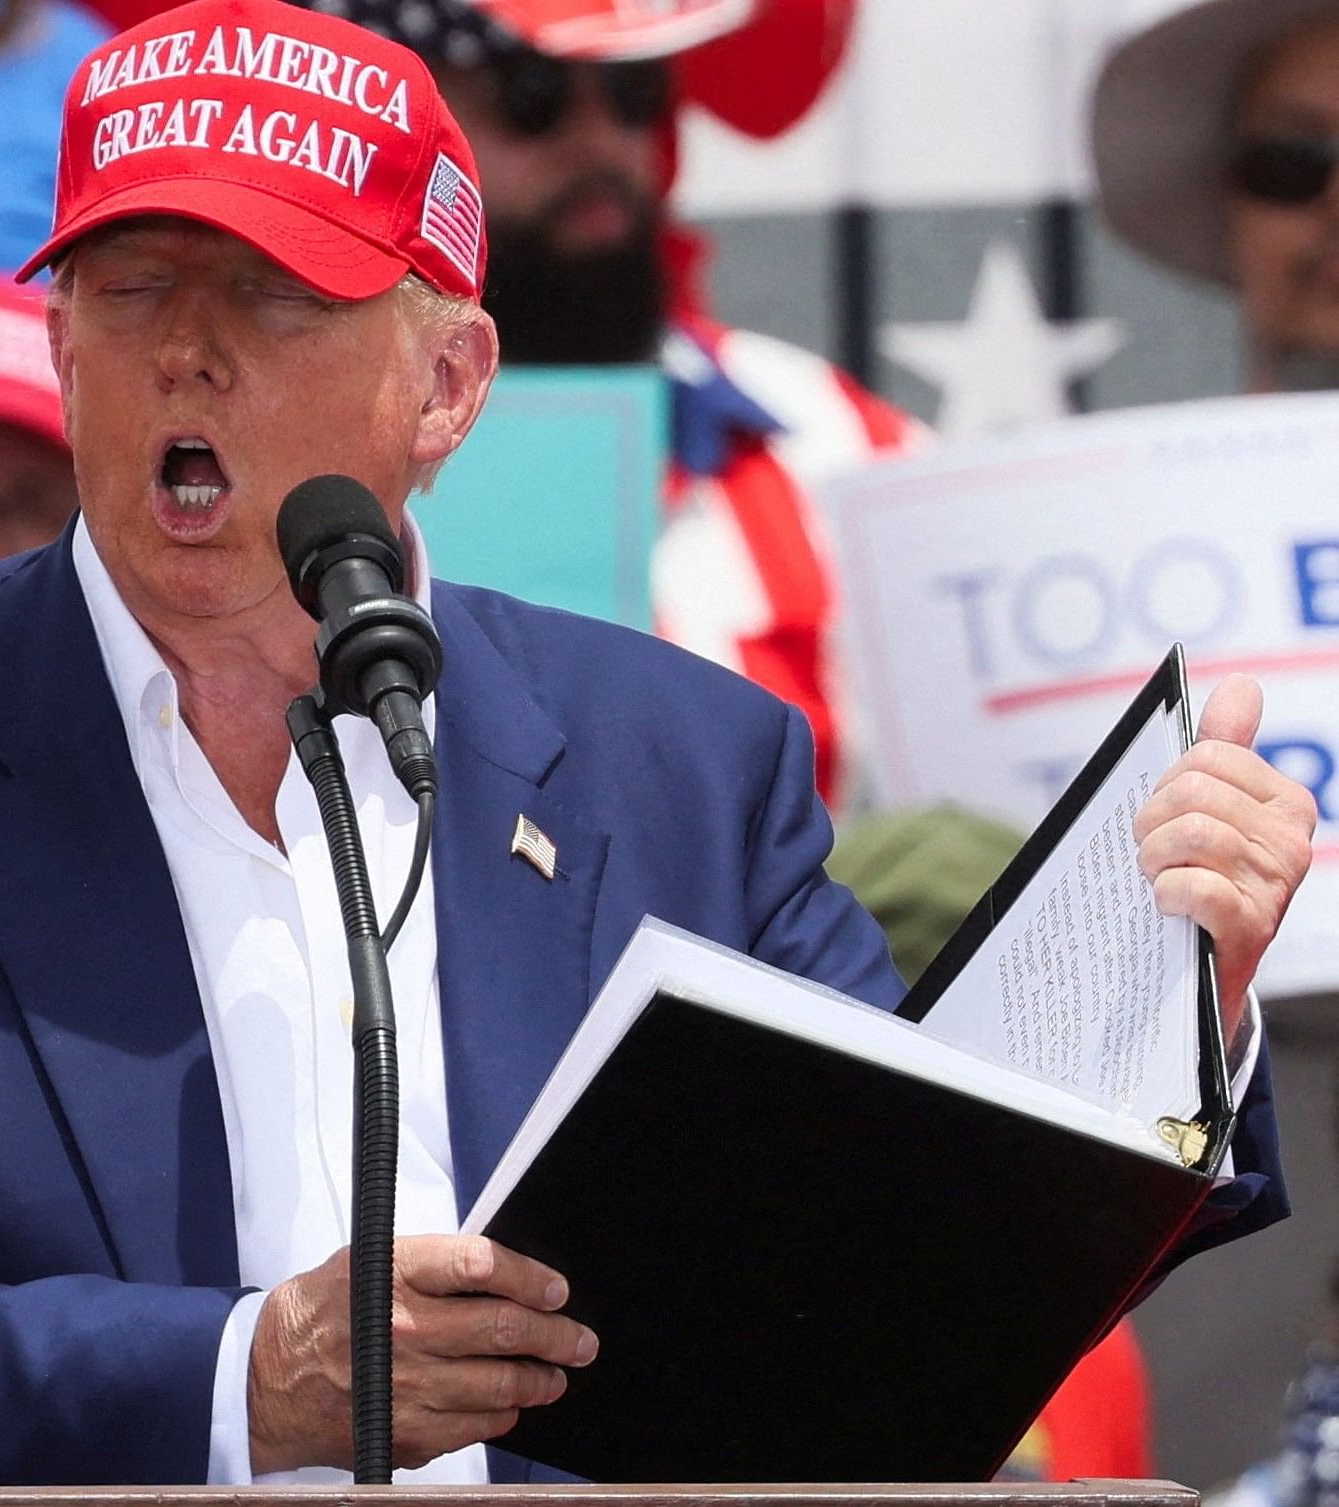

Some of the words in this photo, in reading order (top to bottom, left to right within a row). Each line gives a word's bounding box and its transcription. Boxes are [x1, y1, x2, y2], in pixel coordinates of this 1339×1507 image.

[80, 30, 196, 107] MAKE
[194, 25, 411, 133] AMERICA
[92, 99, 223, 171] GREAT
[222, 104, 378, 196] AGAIN
[930, 538, 1246, 676] TOO
[1102, 817, 1117, 878] beaten
[1114, 804, 1130, 866] student
[1076, 850, 1089, 898] loose
[1090, 833, 1103, 886] Biden
[1060, 870, 1075, 936] Instead
[1110, 878, 1122, 912] and
[1124, 865, 1134, 907] from
[1036, 902, 1046, 933] TO
[1083, 896, 1093, 931] into
[1096, 886, 1111, 950] migrant
[1010, 938, 1024, 984] could
[1039, 932, 1052, 978] HER
[1068, 937, 1078, 956] of
[1086, 933, 1096, 961] our
[1115, 914, 1127, 992] murdered
[1129, 906, 1138, 972] Georgia
[1055, 946, 1068, 992] weak
[1104, 950, 1114, 988] after
[1144, 950, 1153, 980] the
[998, 954, 1014, 1025] correctly
[1006, 1023, 1016, 1044] in
[1016, 984, 1026, 1014] not
[1031, 989, 1042, 1024] And
[1044, 975, 1058, 1044] KILLER
[1060, 993, 1070, 1025] Joe
[1070, 958, 1084, 1050] apologizing
[1090, 964, 1100, 1024] country
[1116, 990, 1127, 1014] by
[1130, 972, 1140, 1008] who
[1138, 981, 1150, 1030] young
[1019, 1014, 1030, 1058] even
[1101, 988, 1114, 1057] Crooked
[1127, 1012, 1136, 1043] was
[1060, 1024, 1070, 1072] Biden
